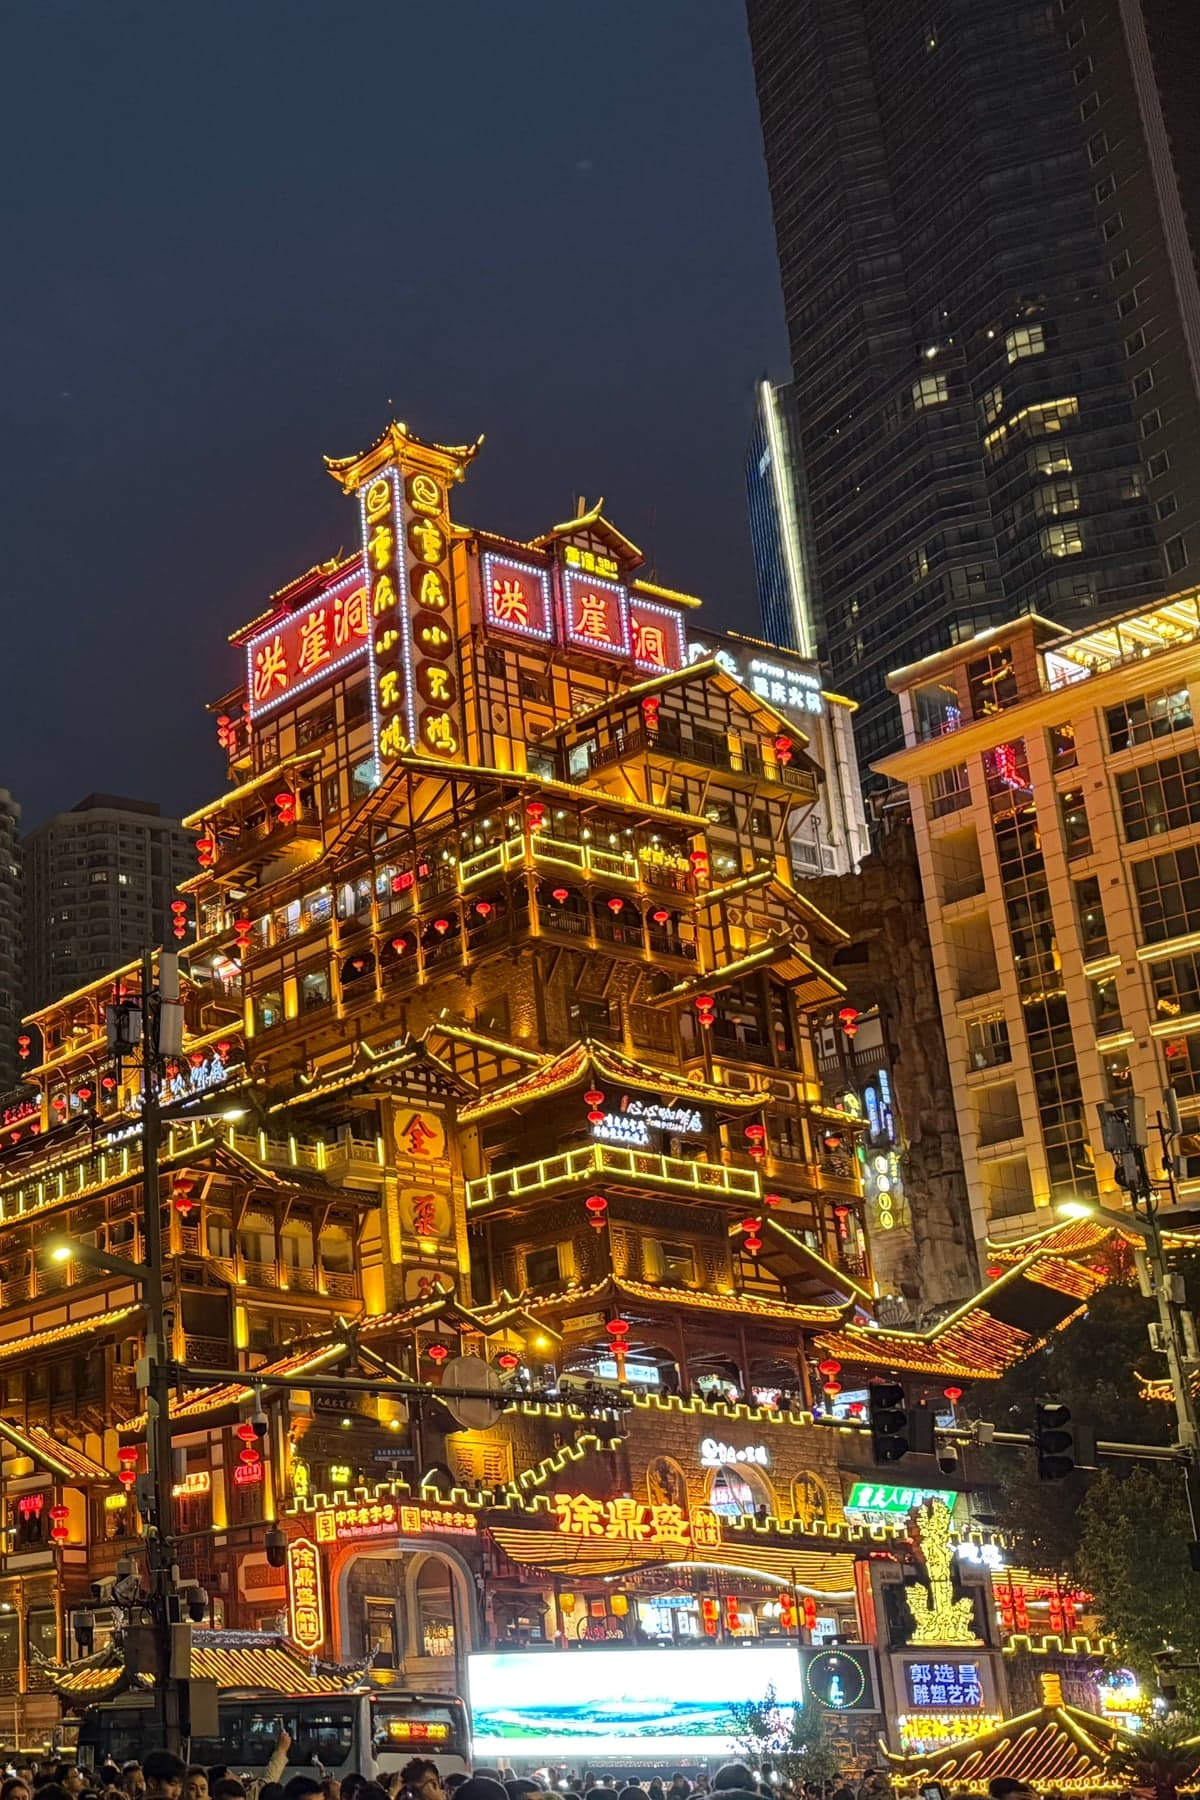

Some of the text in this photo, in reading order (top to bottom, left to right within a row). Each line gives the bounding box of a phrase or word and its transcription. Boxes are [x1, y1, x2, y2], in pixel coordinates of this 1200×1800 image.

[493, 579, 666, 667] 洪崖洞
[254, 586, 369, 700] 洪崖洞
[336, 1504, 396, 1526] 中华老字号
[421, 1508, 478, 1528] 中华老字号
[555, 1493, 691, 1546] 徐鼎盛
[292, 1548, 317, 1607] 徐鼎盛
[910, 1664, 977, 1684] 郭选昌
[913, 1684, 979, 1704] 雕塑艺术
